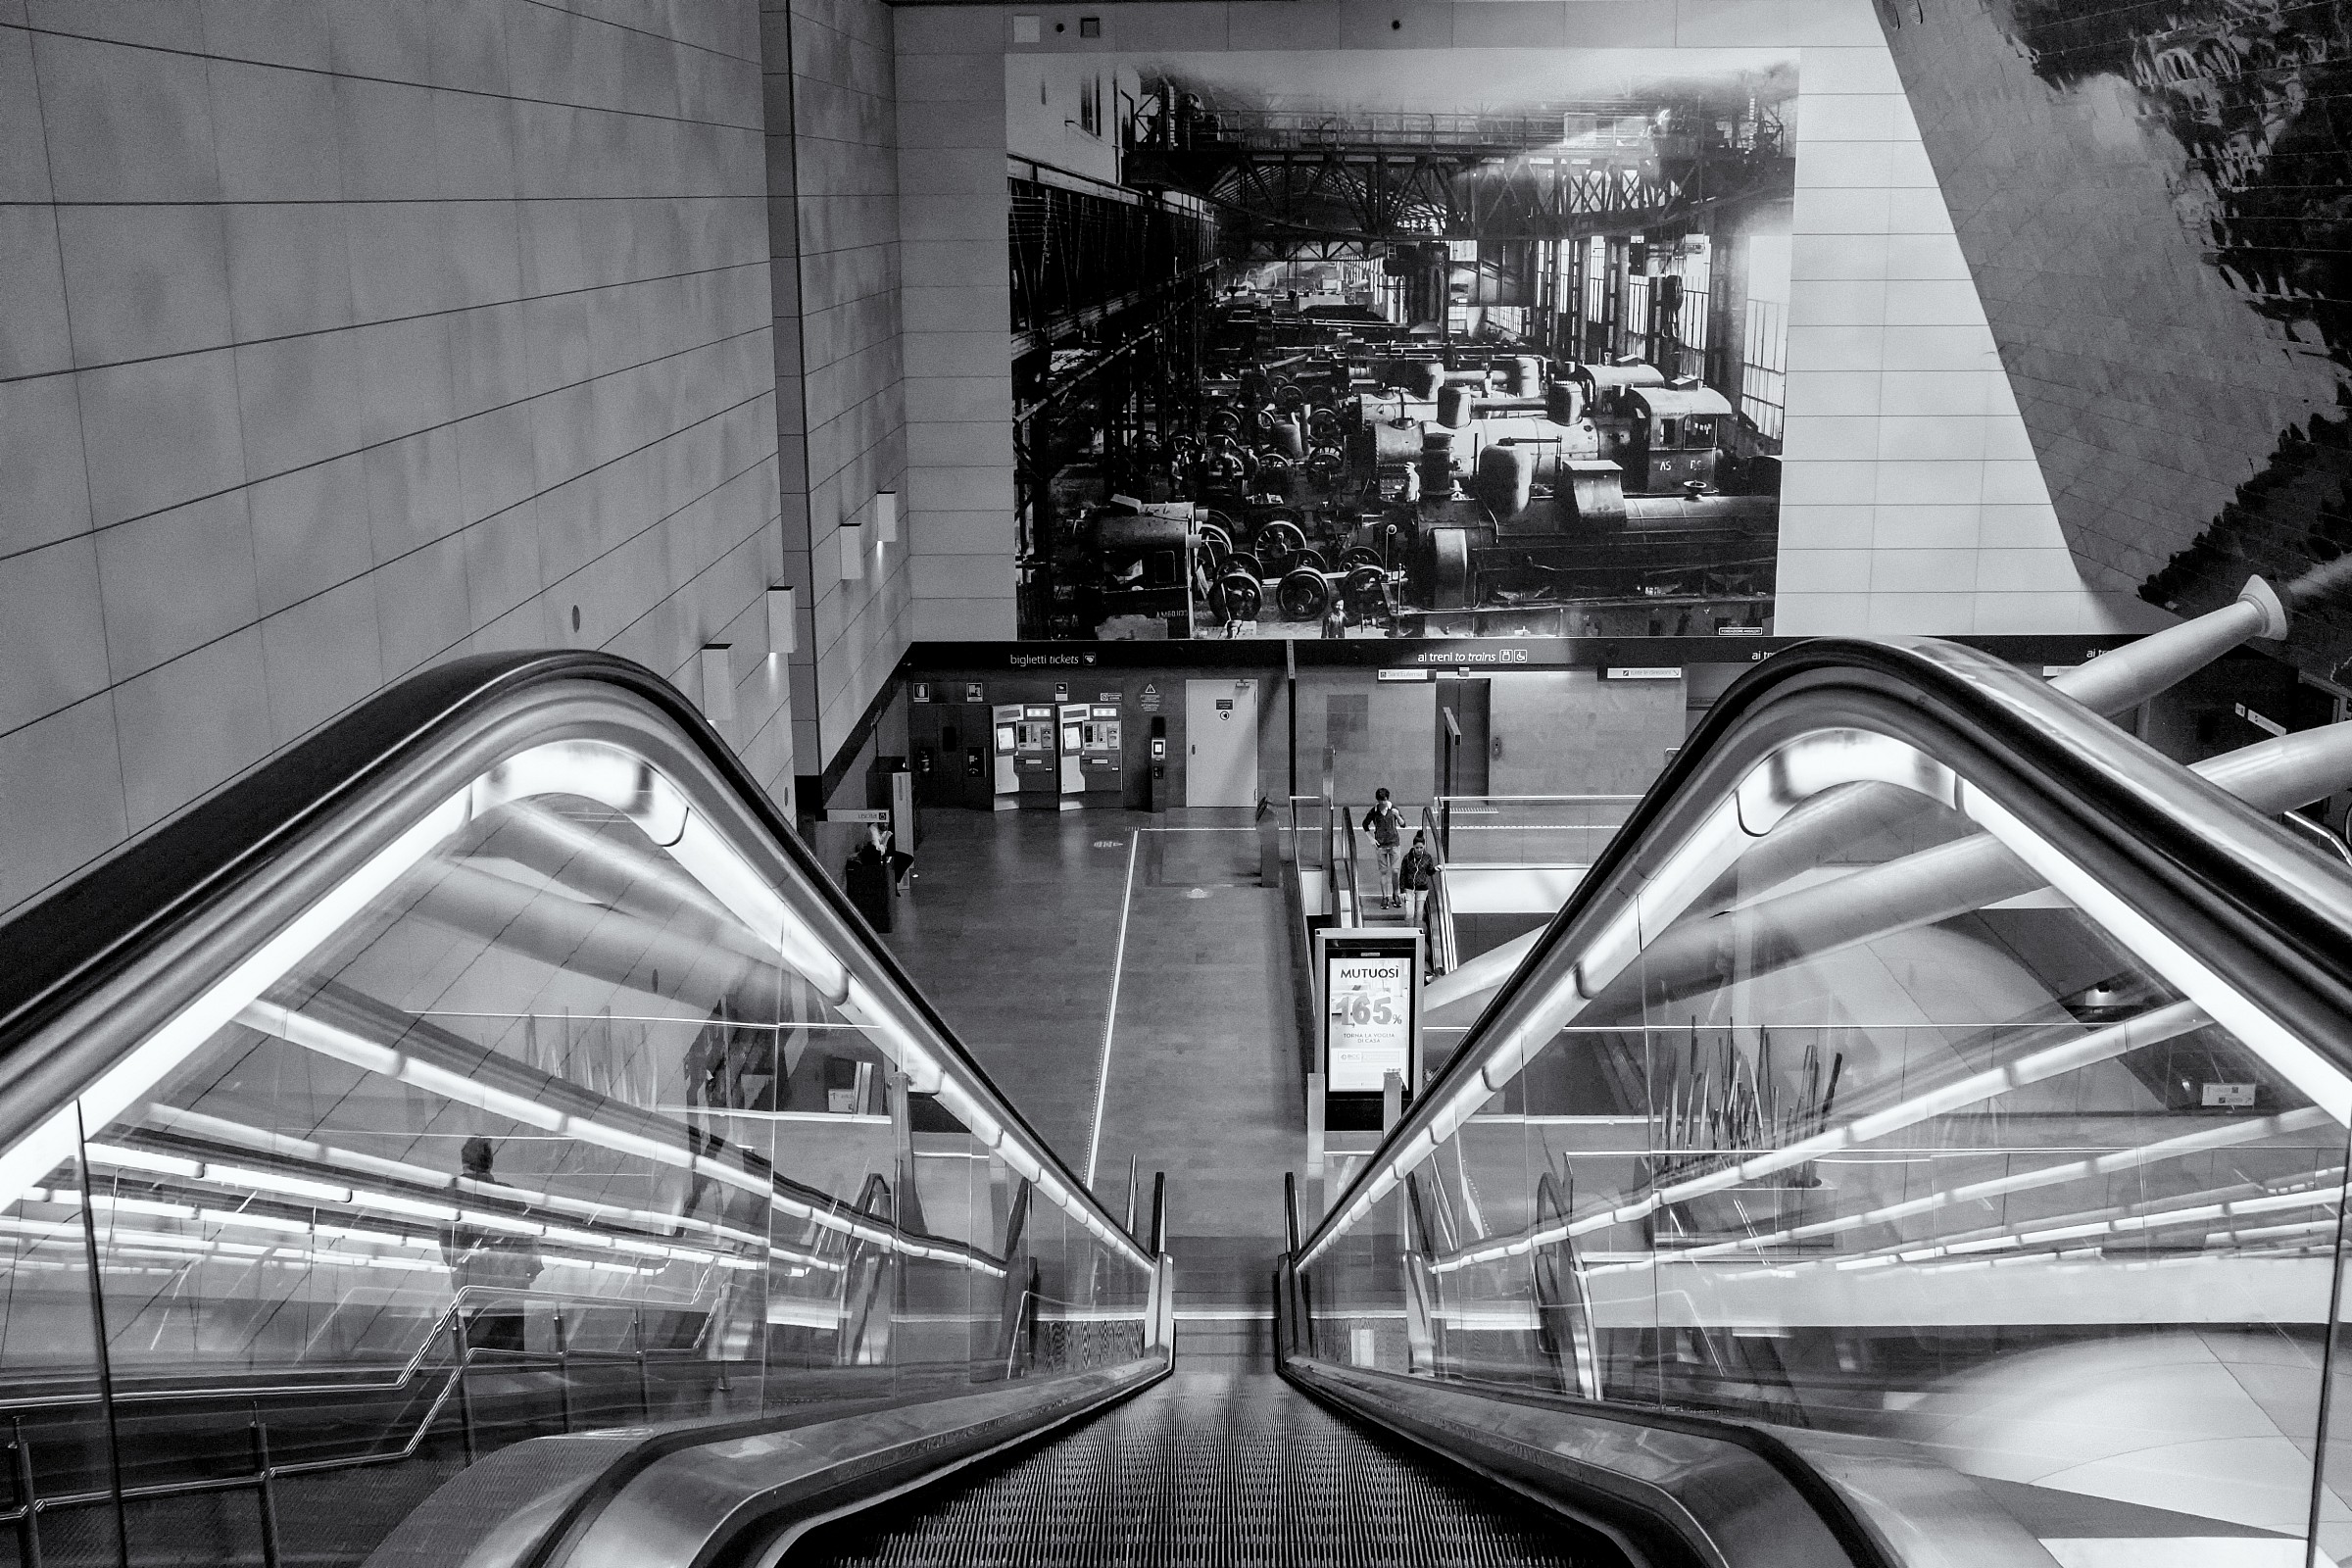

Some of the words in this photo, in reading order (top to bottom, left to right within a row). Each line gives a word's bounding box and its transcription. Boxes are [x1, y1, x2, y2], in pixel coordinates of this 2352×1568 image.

[1417, 652, 1427, 662] ai
[1429, 652, 1452, 662] treni
[1454, 653, 1466, 662] to
[1468, 652, 1496, 662] trains
[1751, 650, 1761, 661] ai
[2086, 648, 2096, 658] ai
[1009, 654, 1047, 666] biglietti
[1050, 654, 1079, 664] tickets
[1340, 964, 1399, 979] MUTUOSÌ
